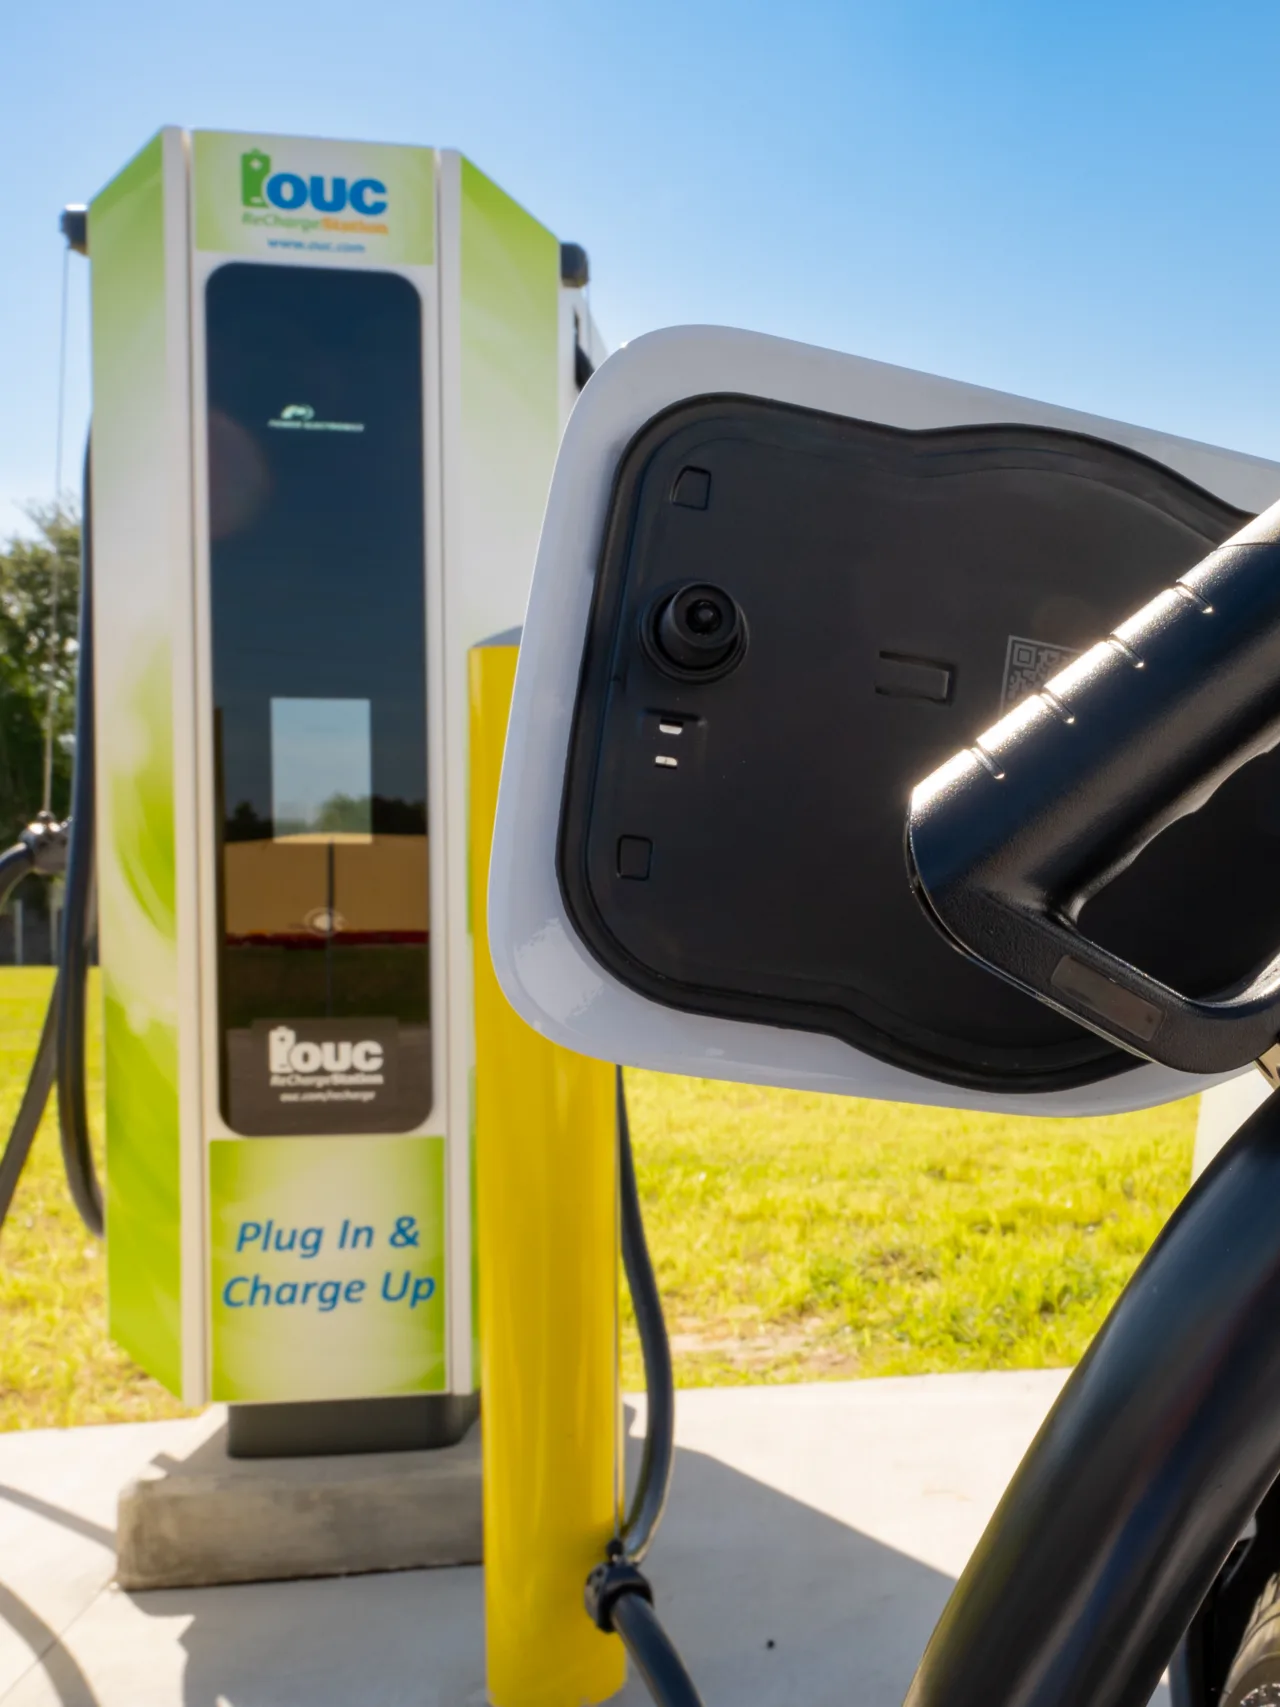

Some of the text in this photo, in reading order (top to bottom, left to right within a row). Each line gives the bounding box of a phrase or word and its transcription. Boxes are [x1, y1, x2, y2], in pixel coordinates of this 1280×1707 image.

[267, 237, 366, 253] www.ouc.com
[235, 1215, 420, 1259] Plug In &
[222, 1269, 436, 1313] Charge Up
